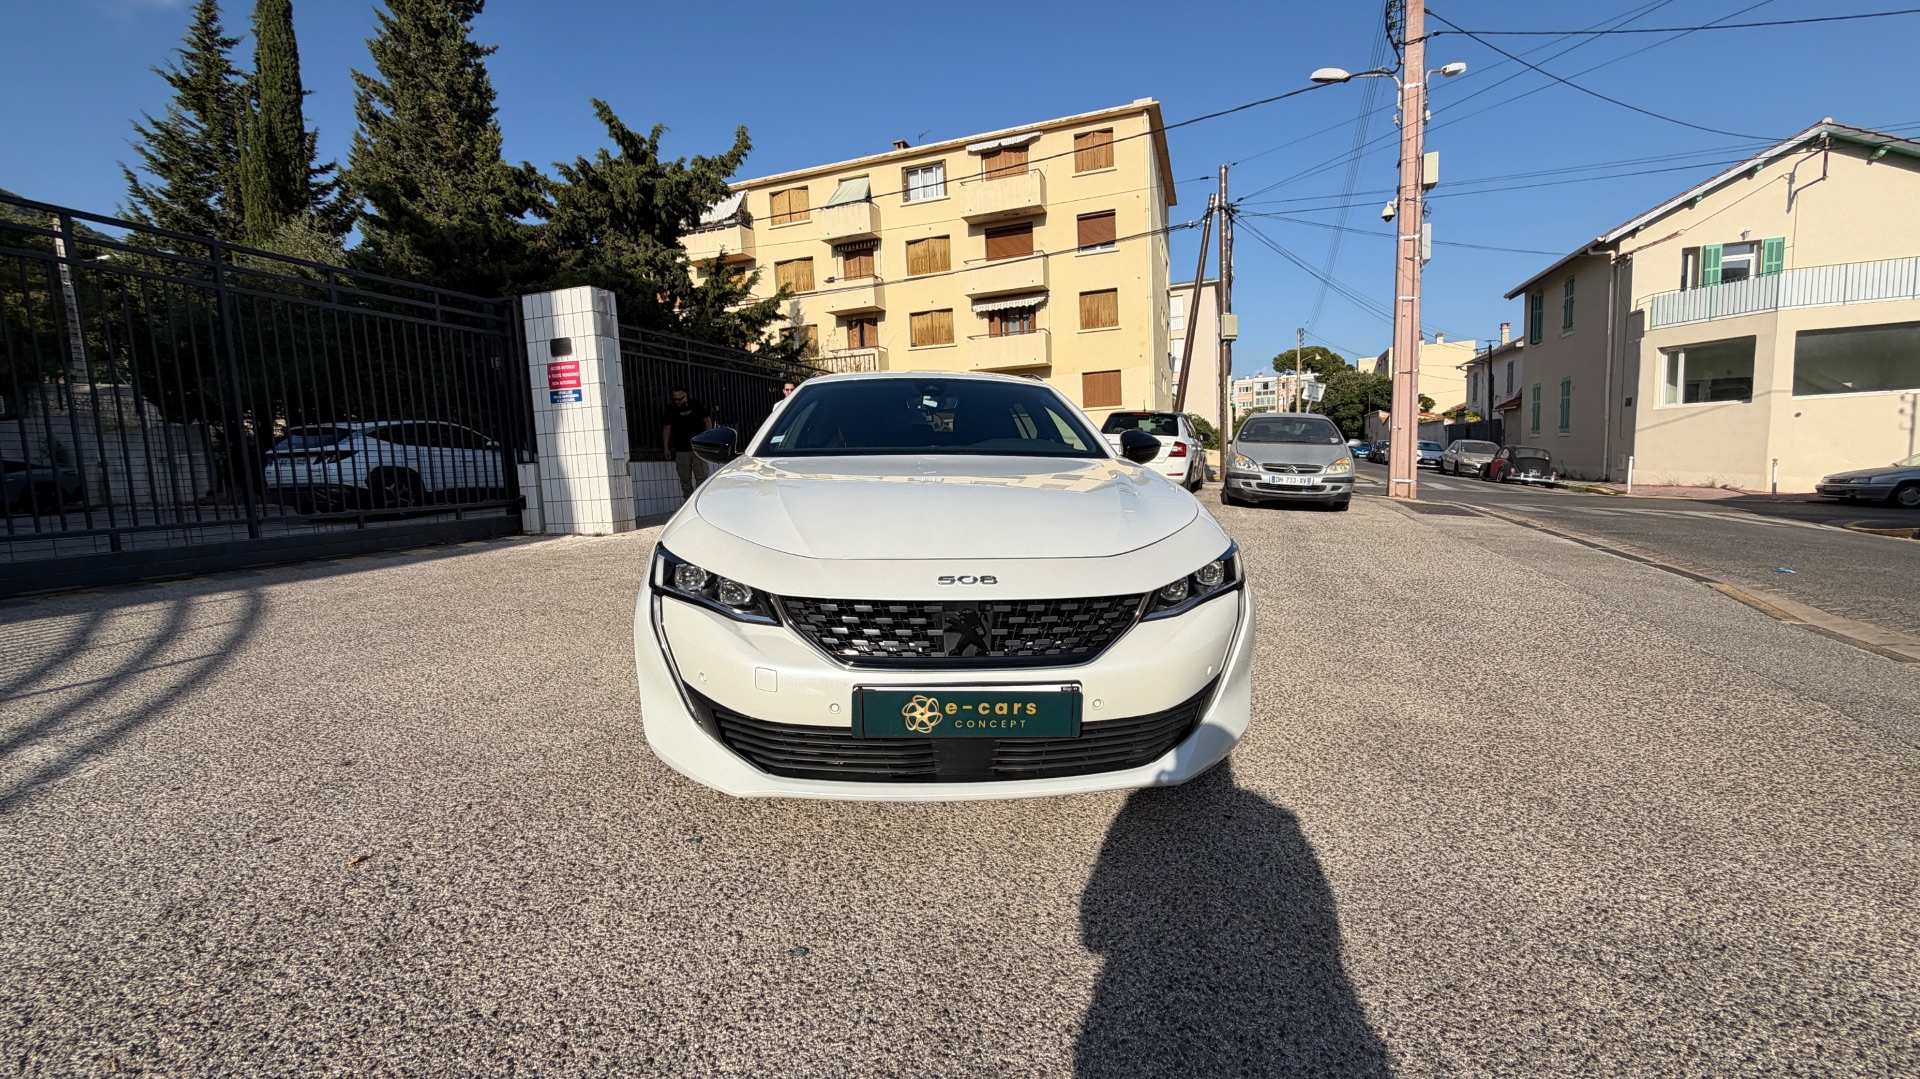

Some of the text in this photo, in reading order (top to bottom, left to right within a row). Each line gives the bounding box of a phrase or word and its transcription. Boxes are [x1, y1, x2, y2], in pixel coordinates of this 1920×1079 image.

[937, 575, 998, 585] 508
[945, 702, 1037, 715] e-cars
[954, 720, 1026, 728] CONCEPT
